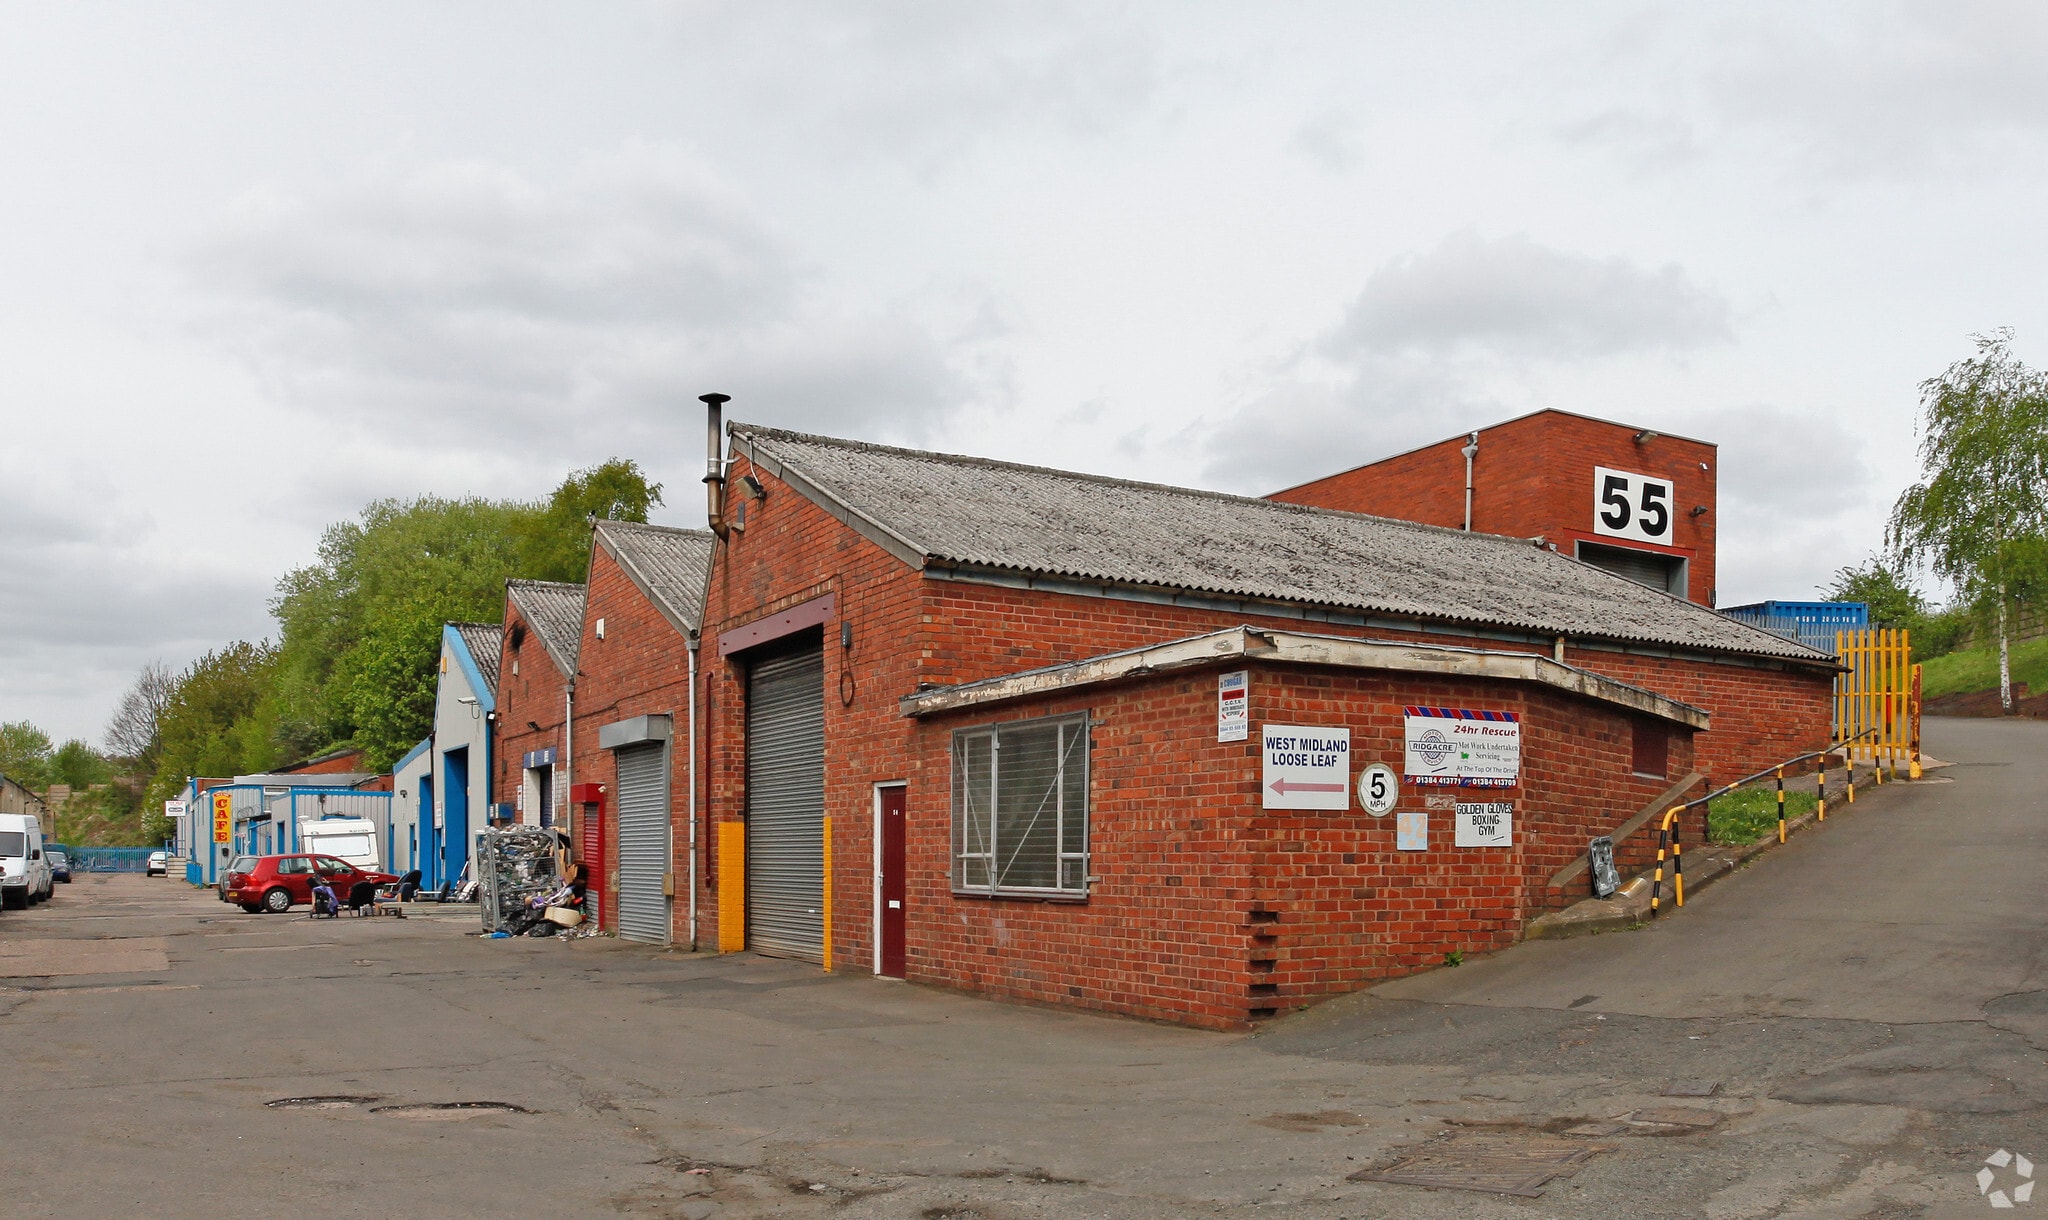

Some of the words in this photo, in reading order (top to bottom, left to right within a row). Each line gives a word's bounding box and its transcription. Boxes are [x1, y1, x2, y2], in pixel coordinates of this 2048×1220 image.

[1600, 475, 1667, 537] 55
[1453, 725, 1479, 735] 24hr
[1481, 726, 1517, 737] Rescue
[1266, 737, 1296, 751] WEST
[1299, 738, 1348, 752] MIDLAND
[1412, 743, 1453, 751] RIDGACRE
[1470, 742, 1486, 750] Work
[1487, 742, 1518, 752] Undertaken
[1272, 753, 1308, 766] LOOSE
[1311, 754, 1337, 768] LEAF
[1475, 752, 1500, 761] Servicing
[1370, 773, 1386, 799] 5
[1416, 776, 1437, 784] 01384
[1439, 777, 1461, 785] 413771
[1472, 777, 1493, 785] 01384
[1456, 804, 1484, 814] GOLDEN
[1488, 803, 1513, 814] GLOVES
[214, 799, 228, 841] CAFE
[1472, 815, 1499, 825] BOXING
[1478, 825, 1495, 836] GYM
